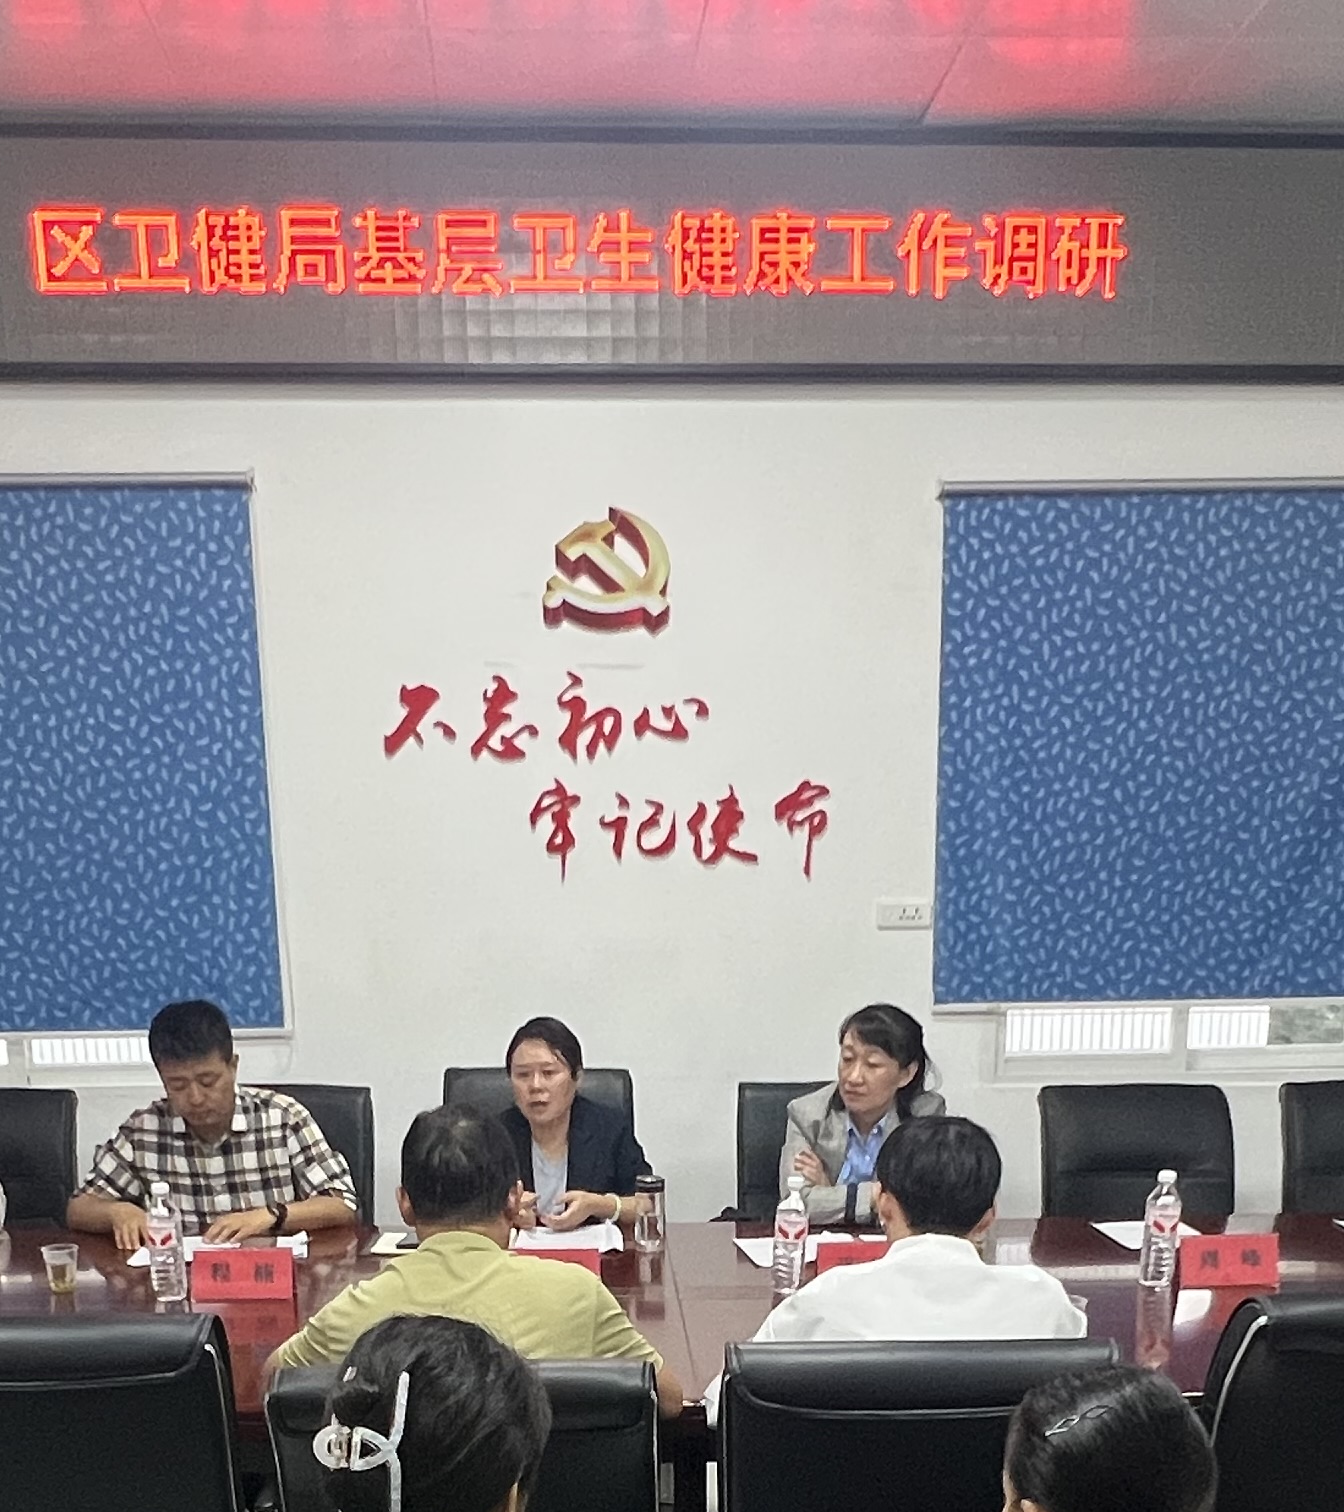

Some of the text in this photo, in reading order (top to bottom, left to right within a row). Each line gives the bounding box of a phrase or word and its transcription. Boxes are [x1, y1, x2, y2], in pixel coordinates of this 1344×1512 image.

[28, 203, 1129, 298] 区卫健局基层卫生健康工作调研
[383, 671, 710, 763] 不忘初心
[528, 779, 830, 881] 牢记使命
